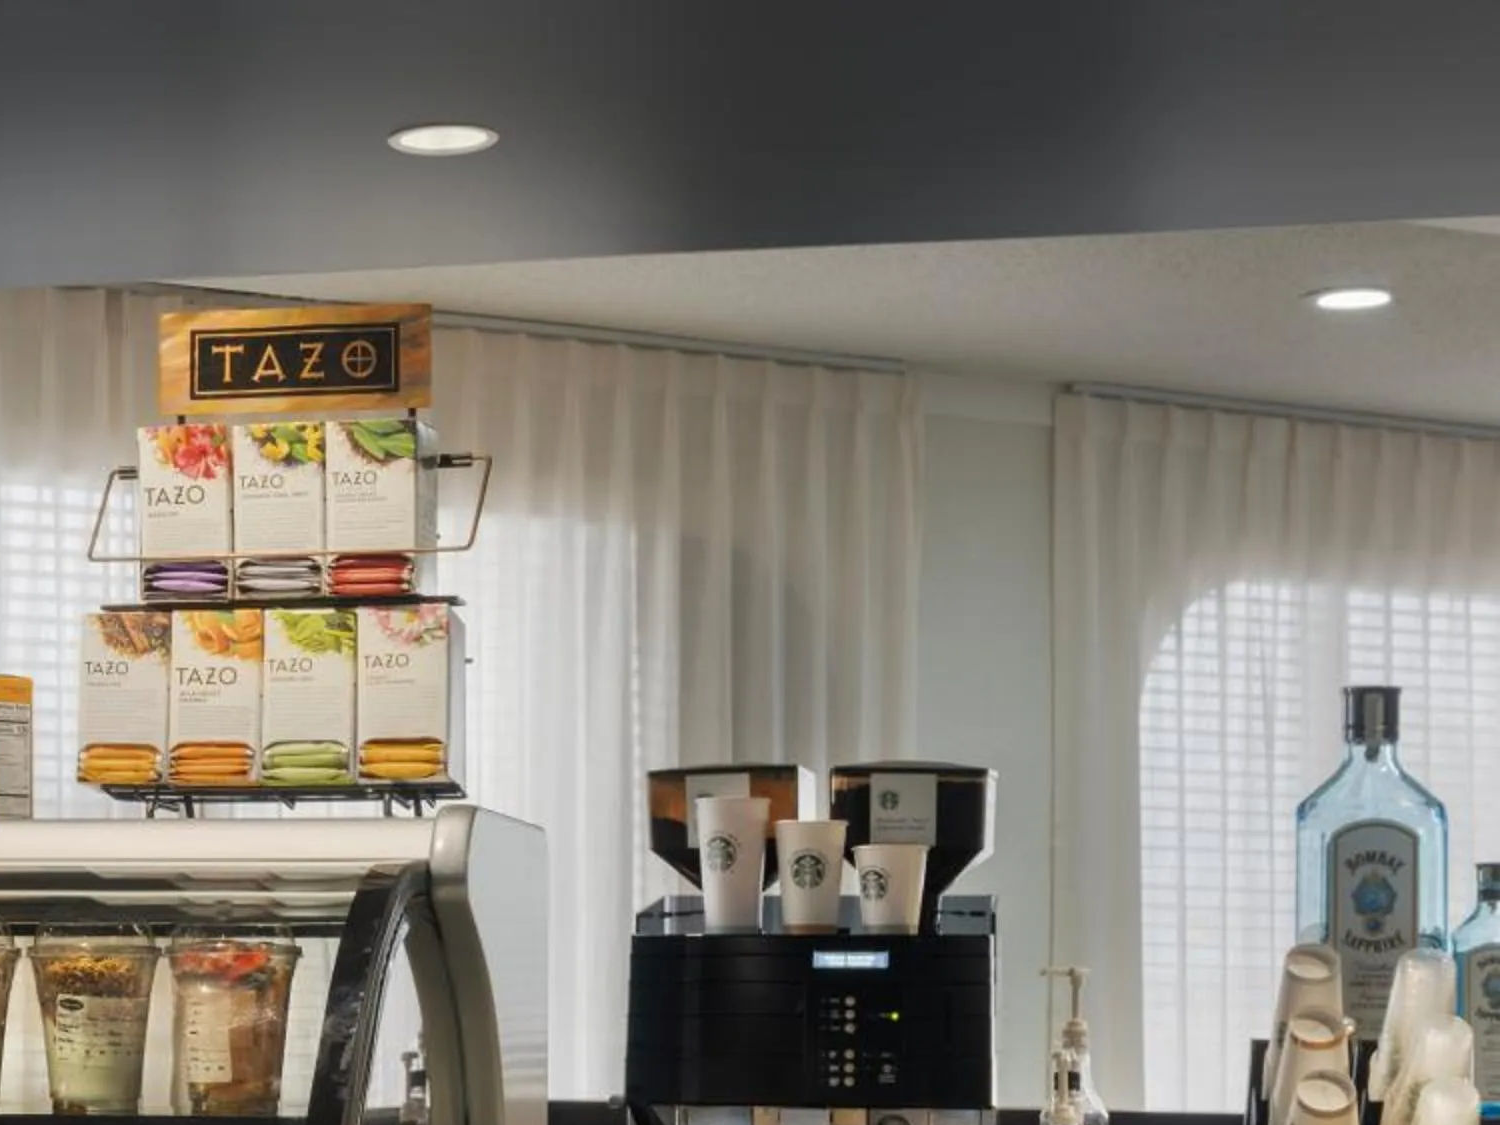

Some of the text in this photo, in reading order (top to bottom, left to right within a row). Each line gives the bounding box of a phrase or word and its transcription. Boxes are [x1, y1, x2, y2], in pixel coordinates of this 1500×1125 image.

[211, 340, 377, 384] TAZO
[239, 473, 284, 490] TAZO
[332, 471, 377, 488] TAZO
[145, 485, 205, 507] TAZO
[84, 661, 129, 676] TAZO
[268, 657, 313, 673] TAZO
[364, 653, 409, 669] TAZO
[176, 666, 237, 686] TAZO
